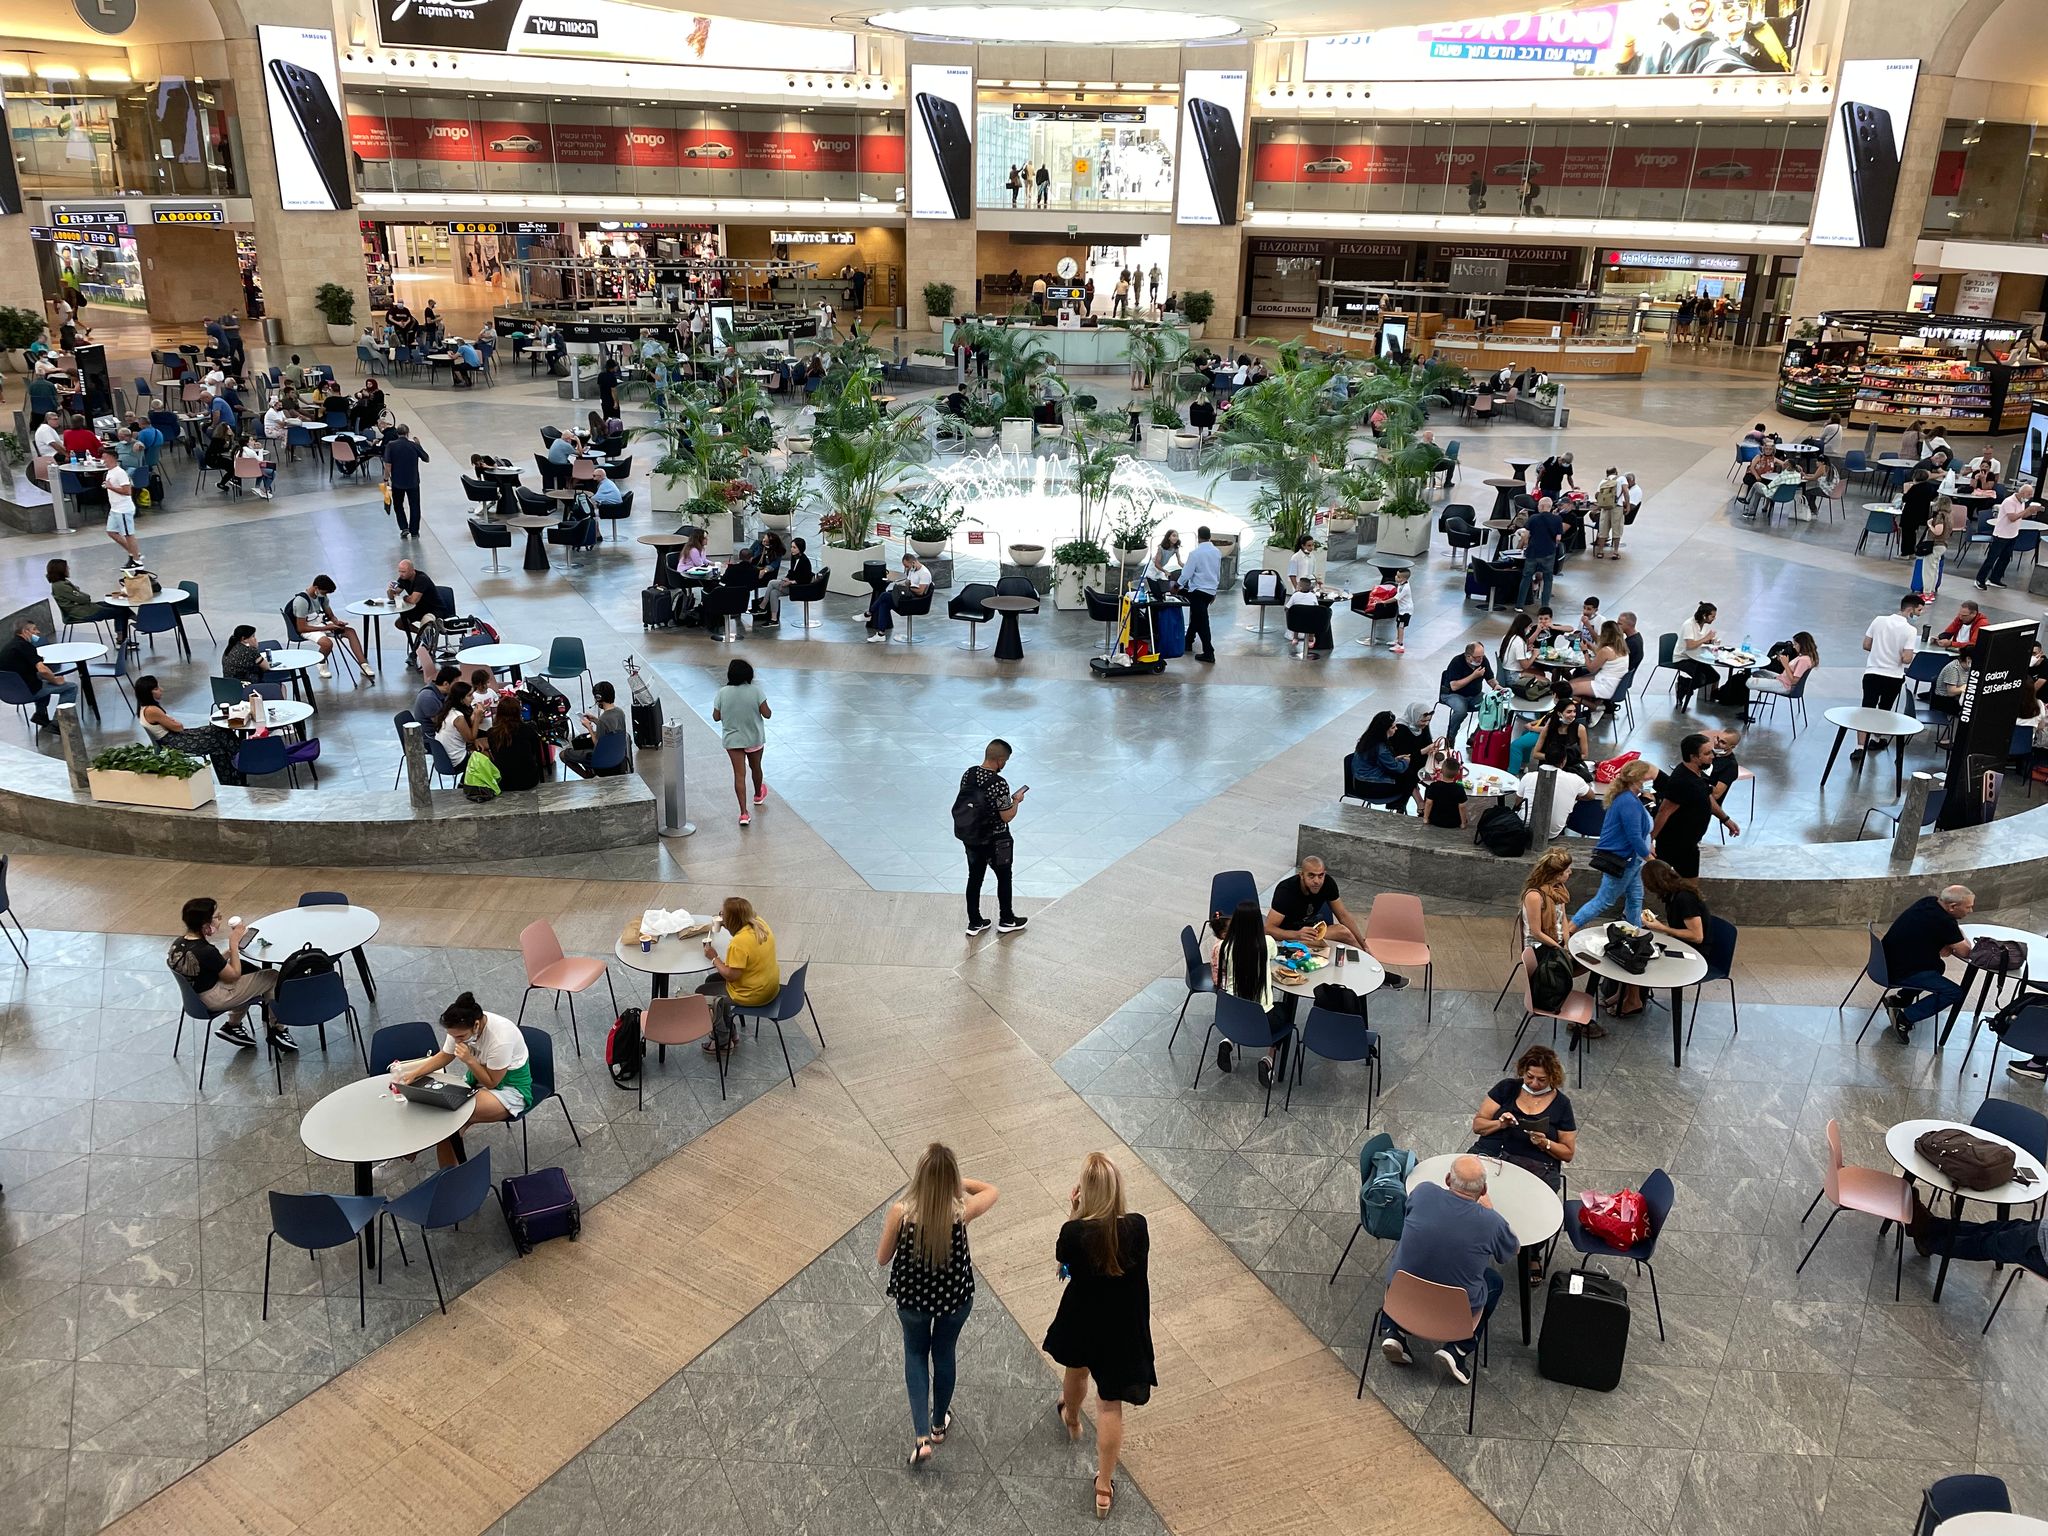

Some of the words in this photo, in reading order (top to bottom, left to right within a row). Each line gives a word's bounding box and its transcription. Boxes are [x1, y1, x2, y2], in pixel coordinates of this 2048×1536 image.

[532, 17, 557, 35] שלך
[1488, 45, 1516, 59] חדש
[1518, 47, 1542, 60] רכב
[1544, 47, 1564, 60] עם
[425, 124, 469, 141] yango
[625, 132, 666, 147] yango
[812, 139, 851, 152] yango
[1435, 151, 1475, 166] yango
[1634, 153, 1678, 168] yango
[774, 233, 829, 243] LUBAVITCH
[1259, 242, 1319, 253] HAZORFIM
[1340, 244, 1401, 255] HAZORFIM
[1440, 247, 1498, 258] הצורפים
[1501, 249, 1568, 260] HAZORFIM
[1621, 252, 1646, 263] bank
[1647, 253, 1692, 265] hapoalim
[1257, 304, 1283, 312] GEORG
[1284, 305, 1311, 313] JENSEN
[1919, 327, 1952, 339] DUTY
[1953, 328, 1983, 340] FREE
[1985, 670, 2009, 681] Galaxy
[1982, 685, 1993, 695] S21
[1993, 681, 2012, 693] Series
[2012, 679, 2022, 689] 5G
[1960, 669, 1980, 723] SAMSUNG
